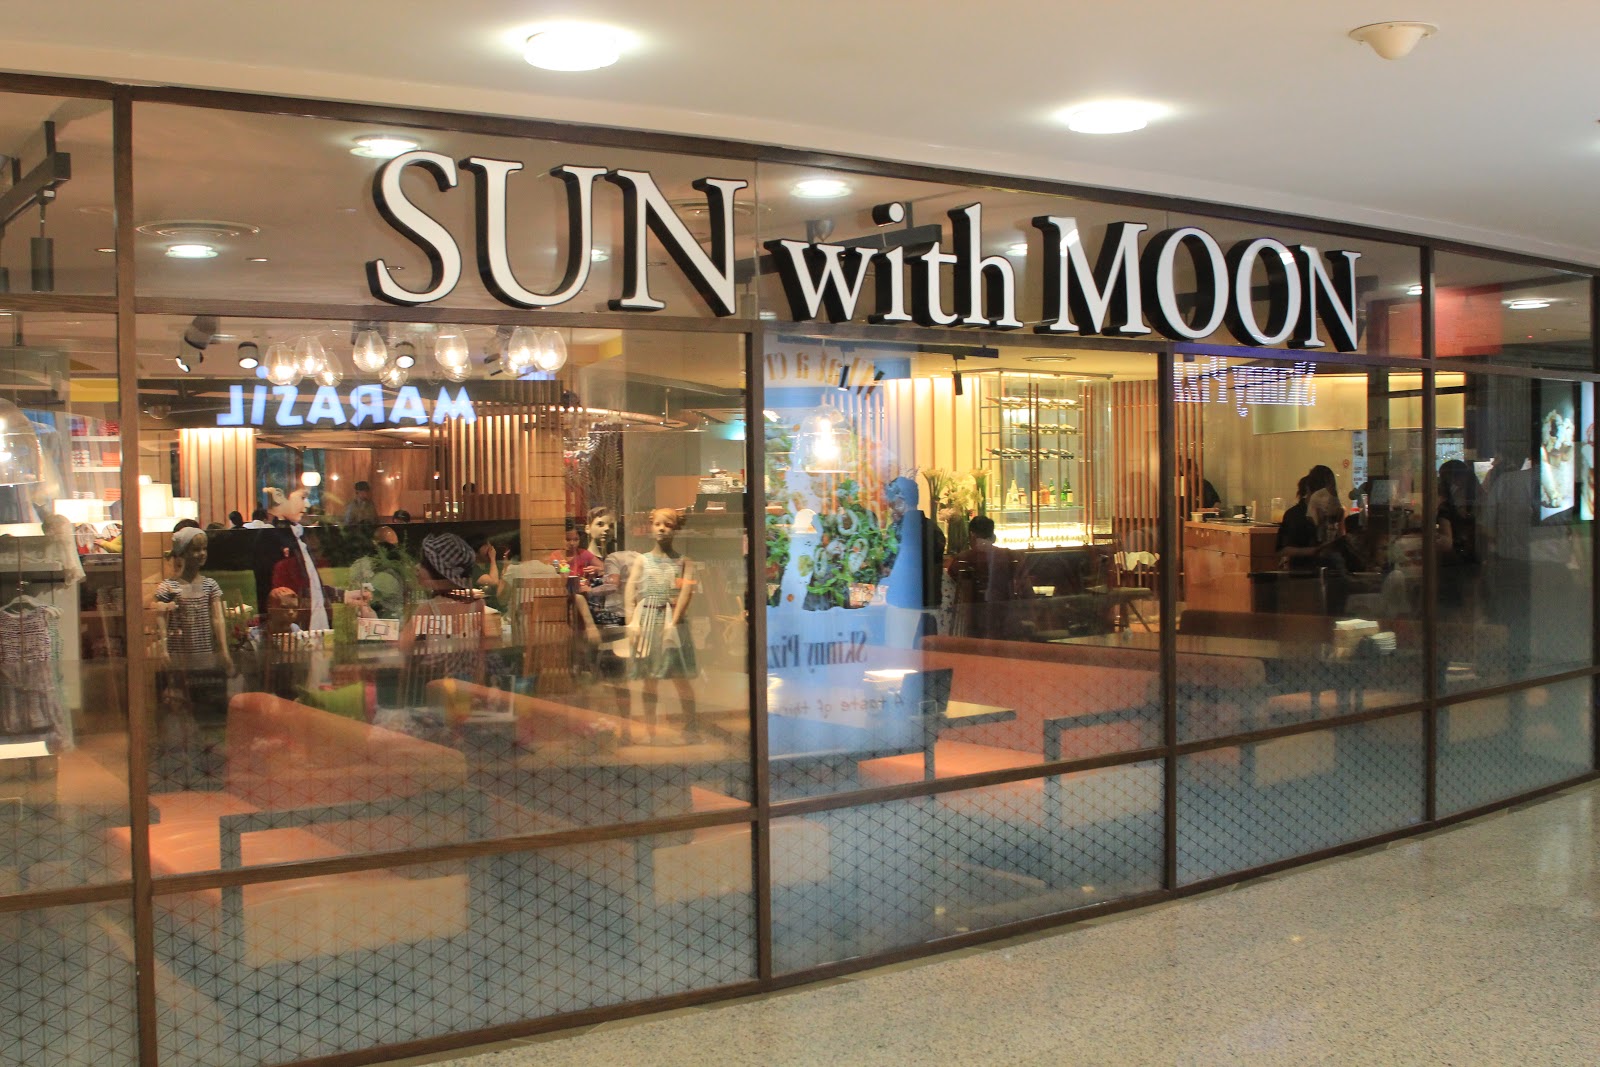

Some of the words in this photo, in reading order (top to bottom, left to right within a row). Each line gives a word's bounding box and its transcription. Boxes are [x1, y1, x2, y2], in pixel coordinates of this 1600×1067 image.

[366, 150, 748, 317] SUN
[763, 202, 1025, 329] with
[1031, 215, 1362, 352] MOON
